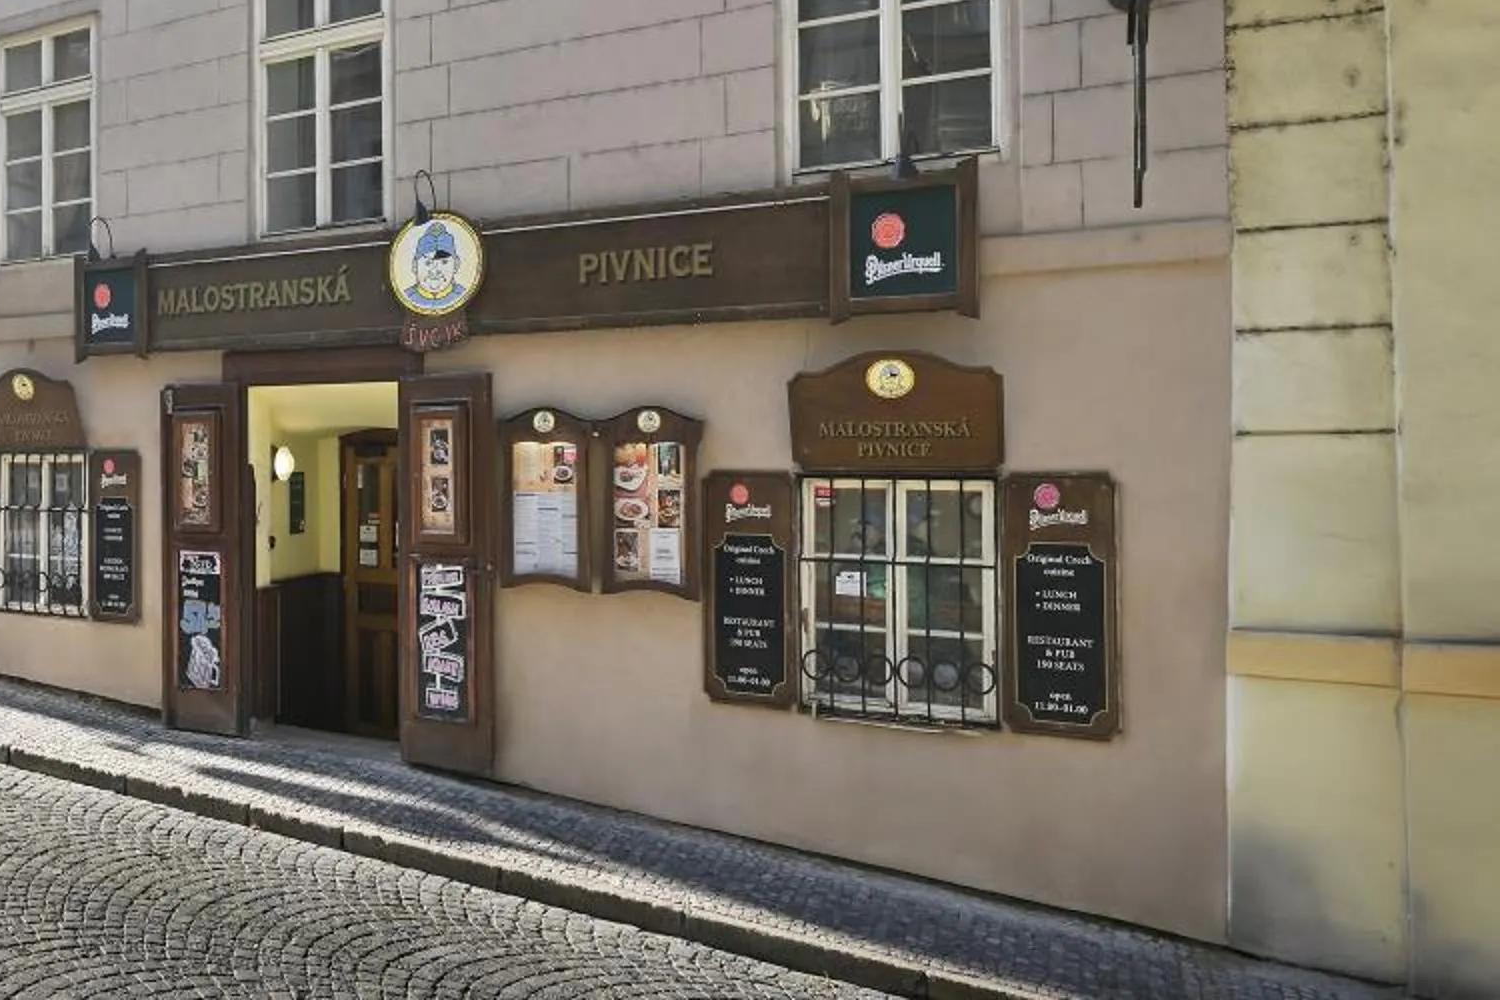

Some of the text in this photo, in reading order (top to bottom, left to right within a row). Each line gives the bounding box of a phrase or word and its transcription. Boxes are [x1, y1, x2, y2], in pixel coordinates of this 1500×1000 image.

[578, 241, 713, 284] PIVNICE
[157, 264, 351, 315] MALOSTRANSKÁ
[818, 417, 972, 439] MALOSTRANSKÁ
[857, 441, 932, 458] PIVNICE
[1042, 589, 1077, 599] LUNCH
[1027, 635, 1094, 648] RESTAURANT
